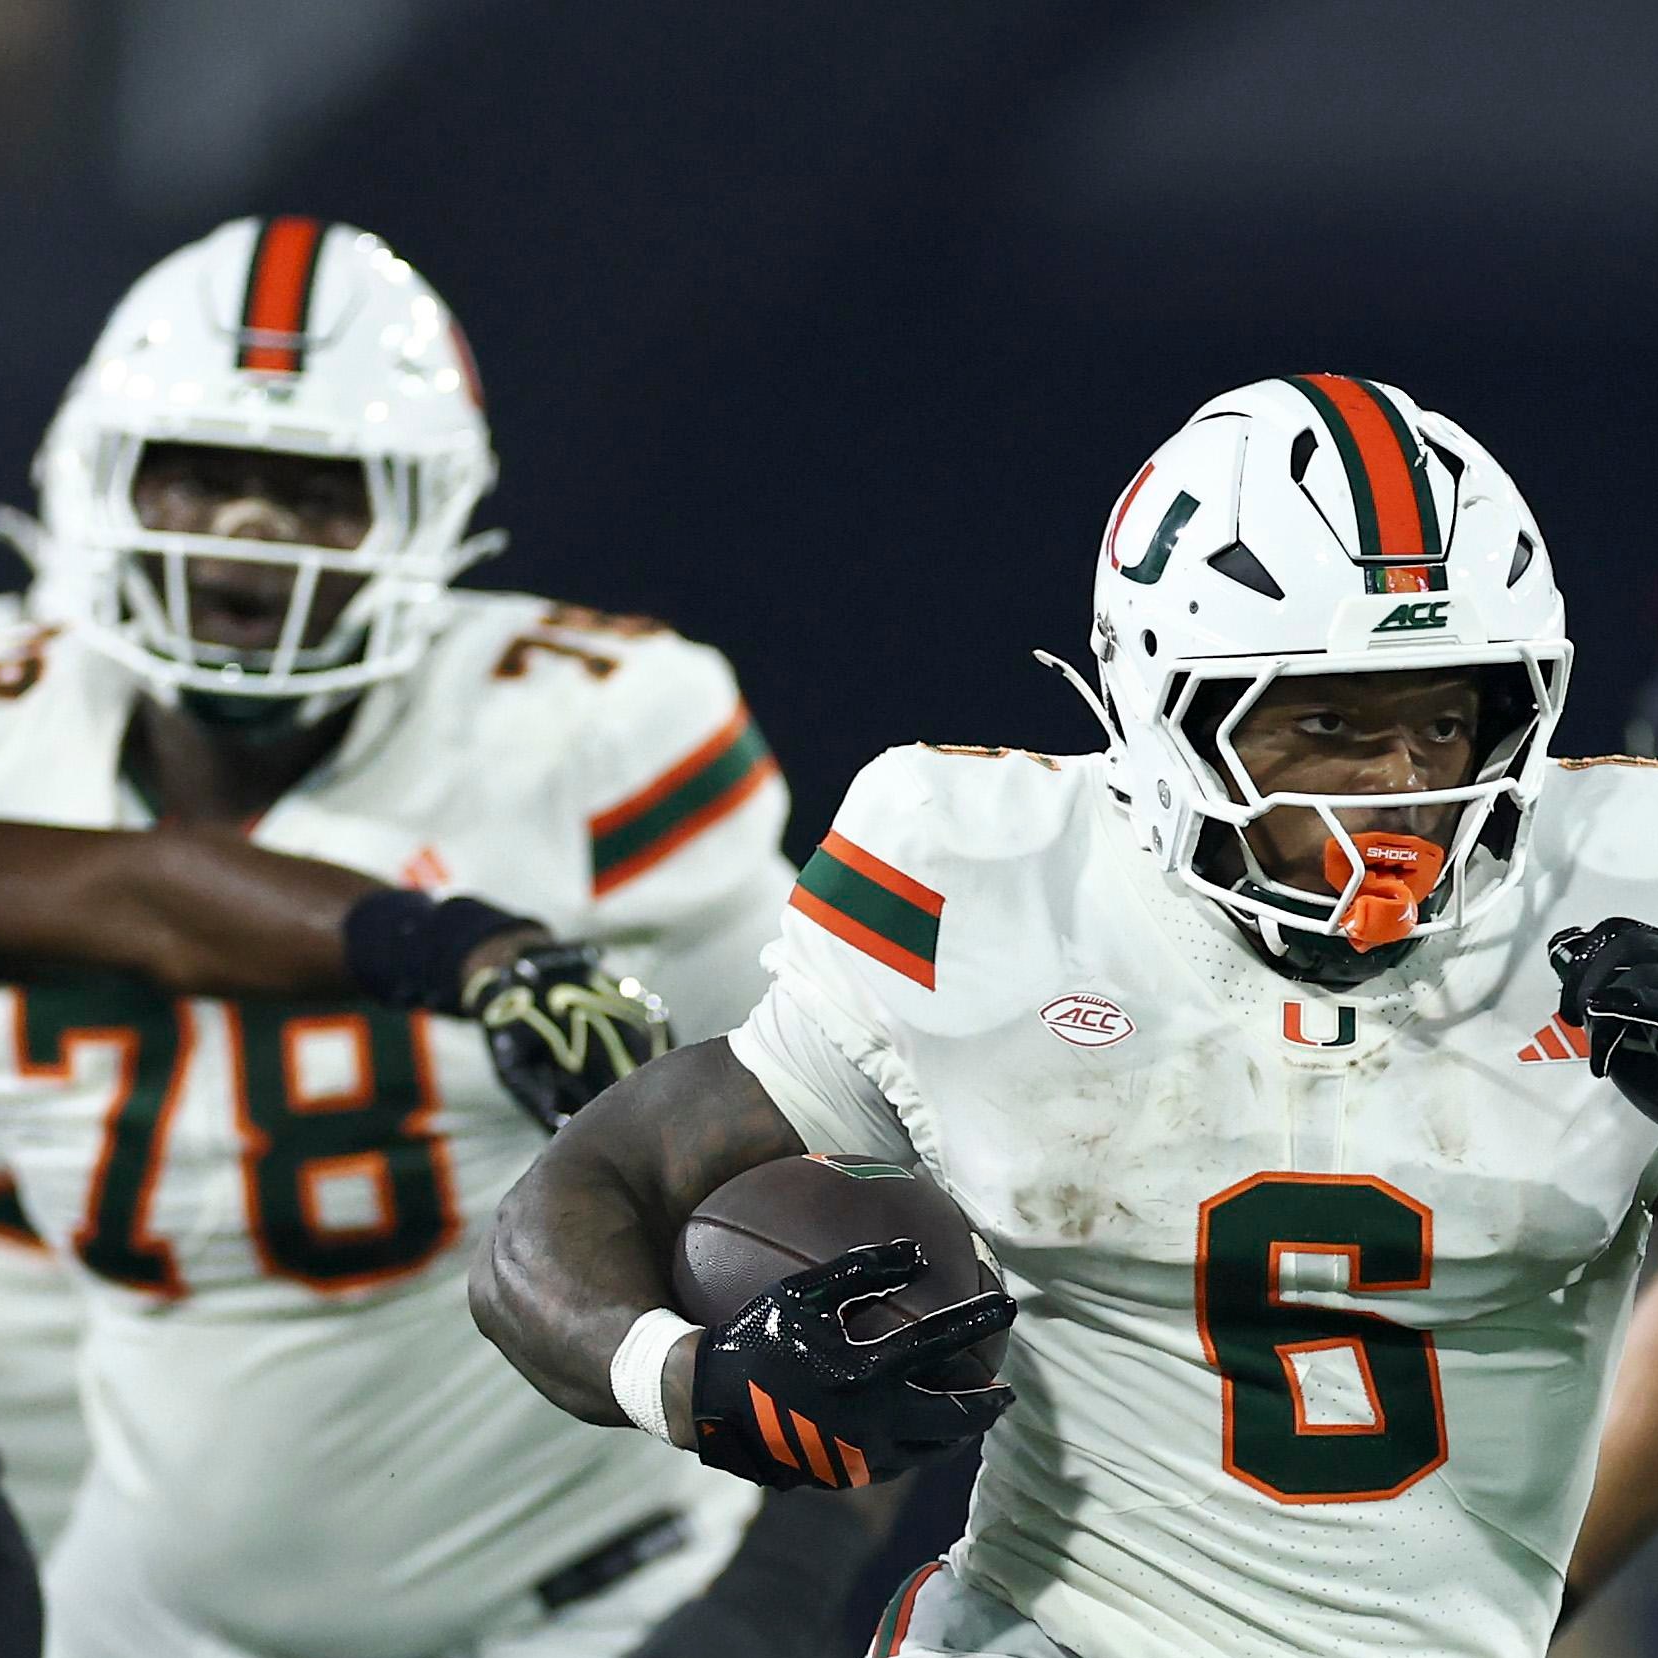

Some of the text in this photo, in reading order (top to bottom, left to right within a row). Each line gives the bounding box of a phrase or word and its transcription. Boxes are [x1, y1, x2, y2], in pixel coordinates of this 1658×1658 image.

[1371, 601, 1451, 632] ACC
[1366, 847, 1418, 861] SHOCK
[1054, 1007, 1122, 1031] ACC
[1283, 1001, 1357, 1048] U
[13, 985, 463, 1298] 78
[1196, 1171, 1448, 1505] 6
